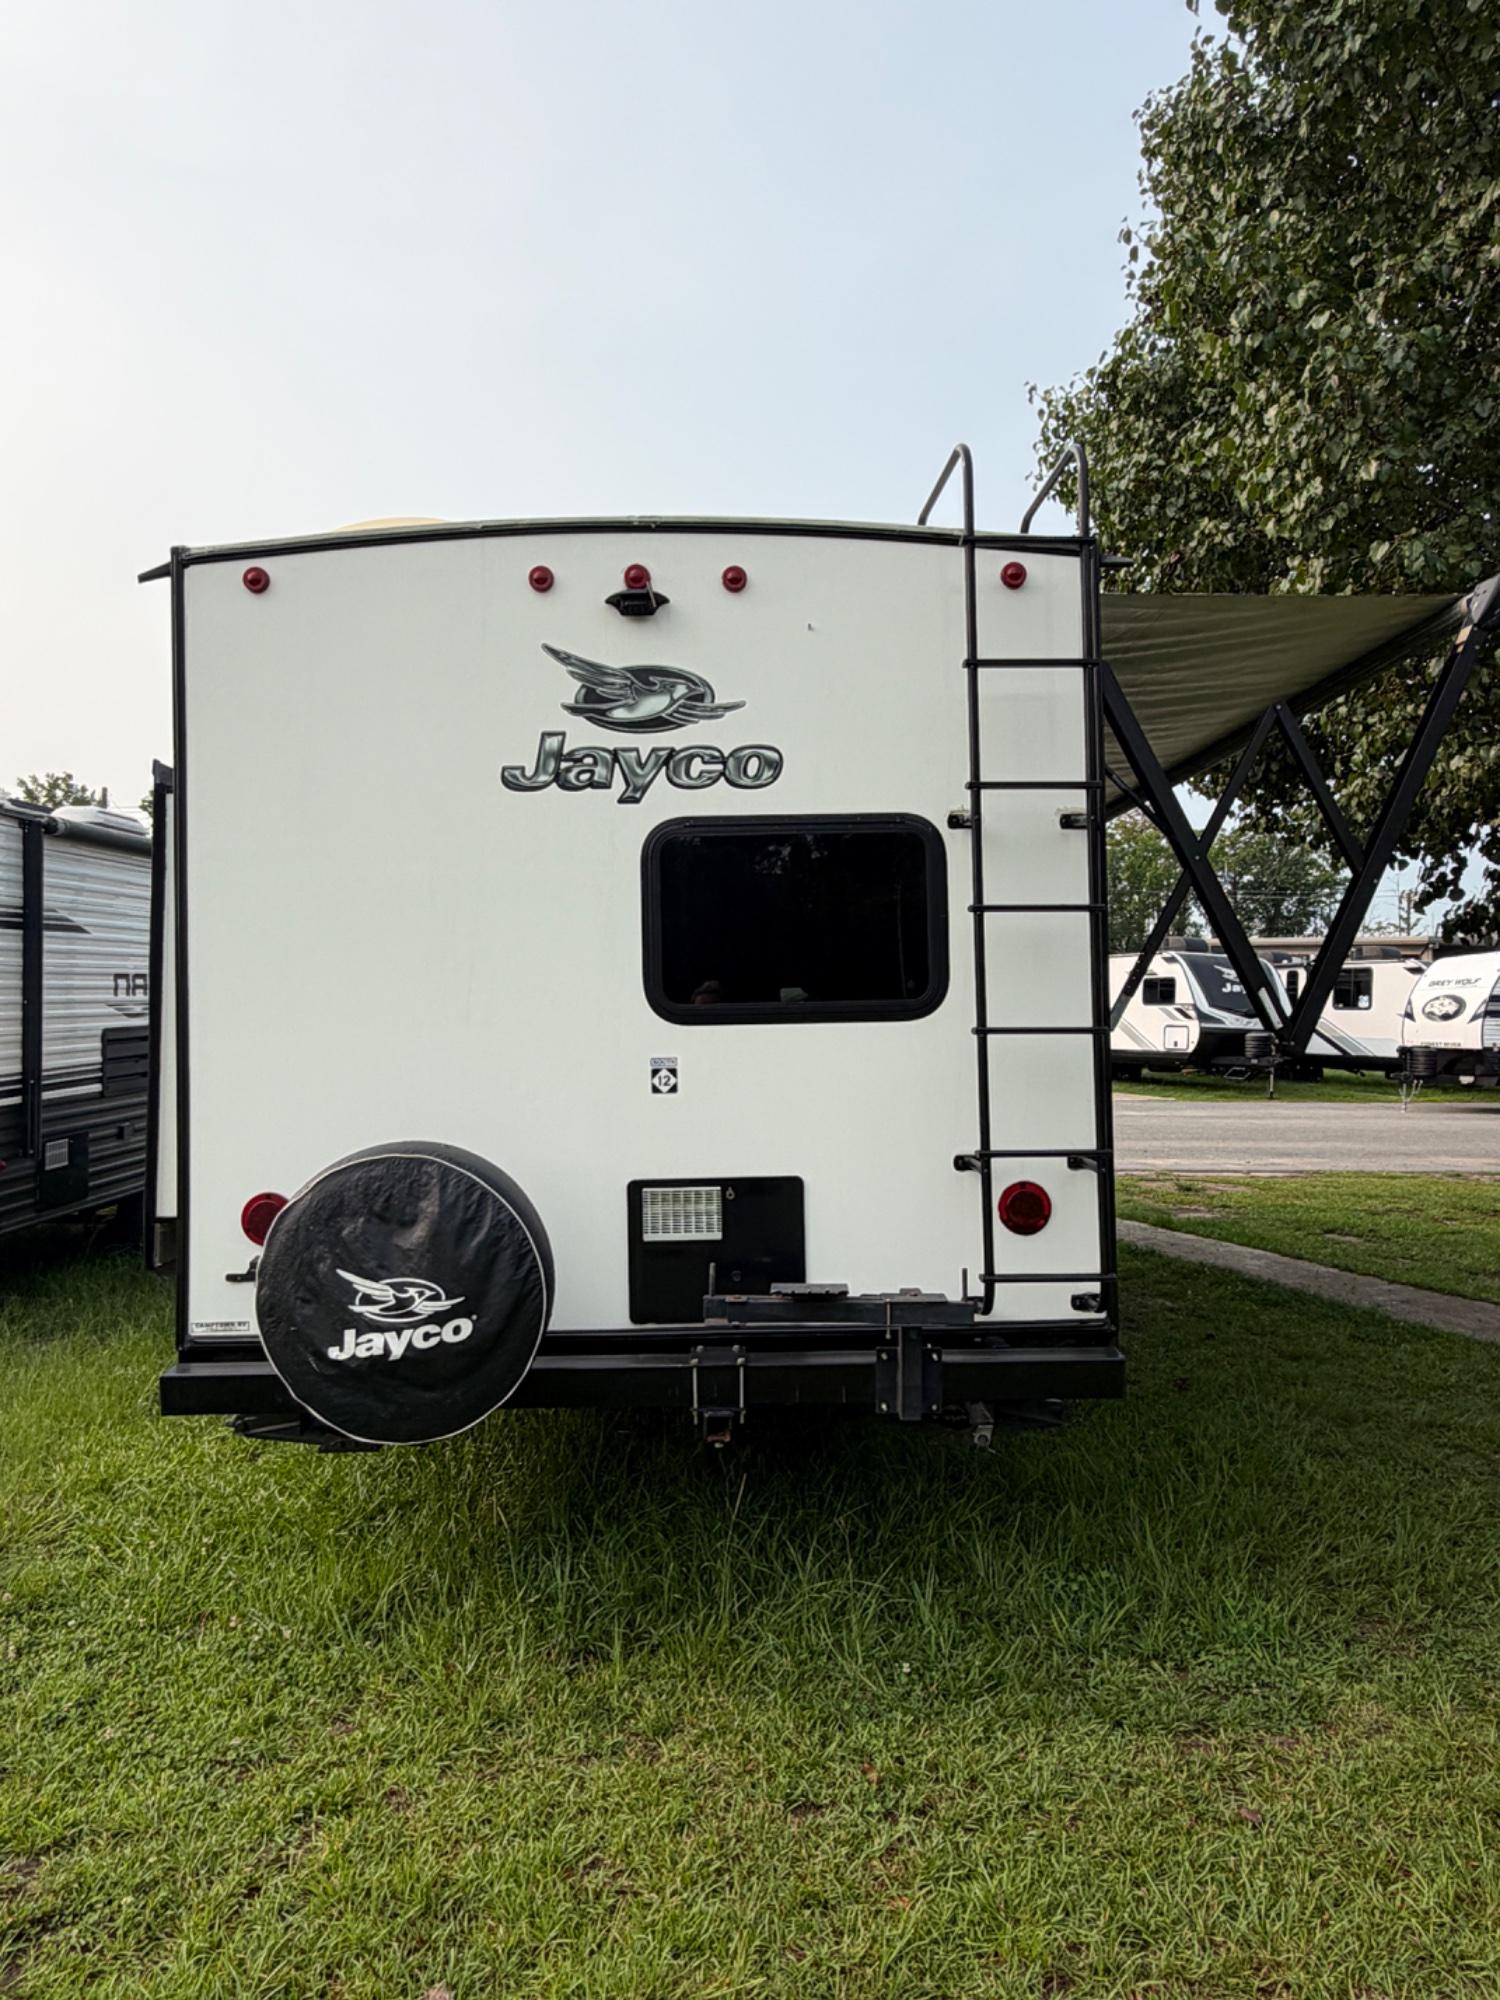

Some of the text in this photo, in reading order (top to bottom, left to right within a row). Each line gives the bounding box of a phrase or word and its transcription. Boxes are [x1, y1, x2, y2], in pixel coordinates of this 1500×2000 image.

[501, 731, 784, 804] Jayco
[1428, 977, 1482, 987] GREY WOLF
[658, 1075, 671, 1087] 12
[327, 1317, 474, 1361] Jayco
